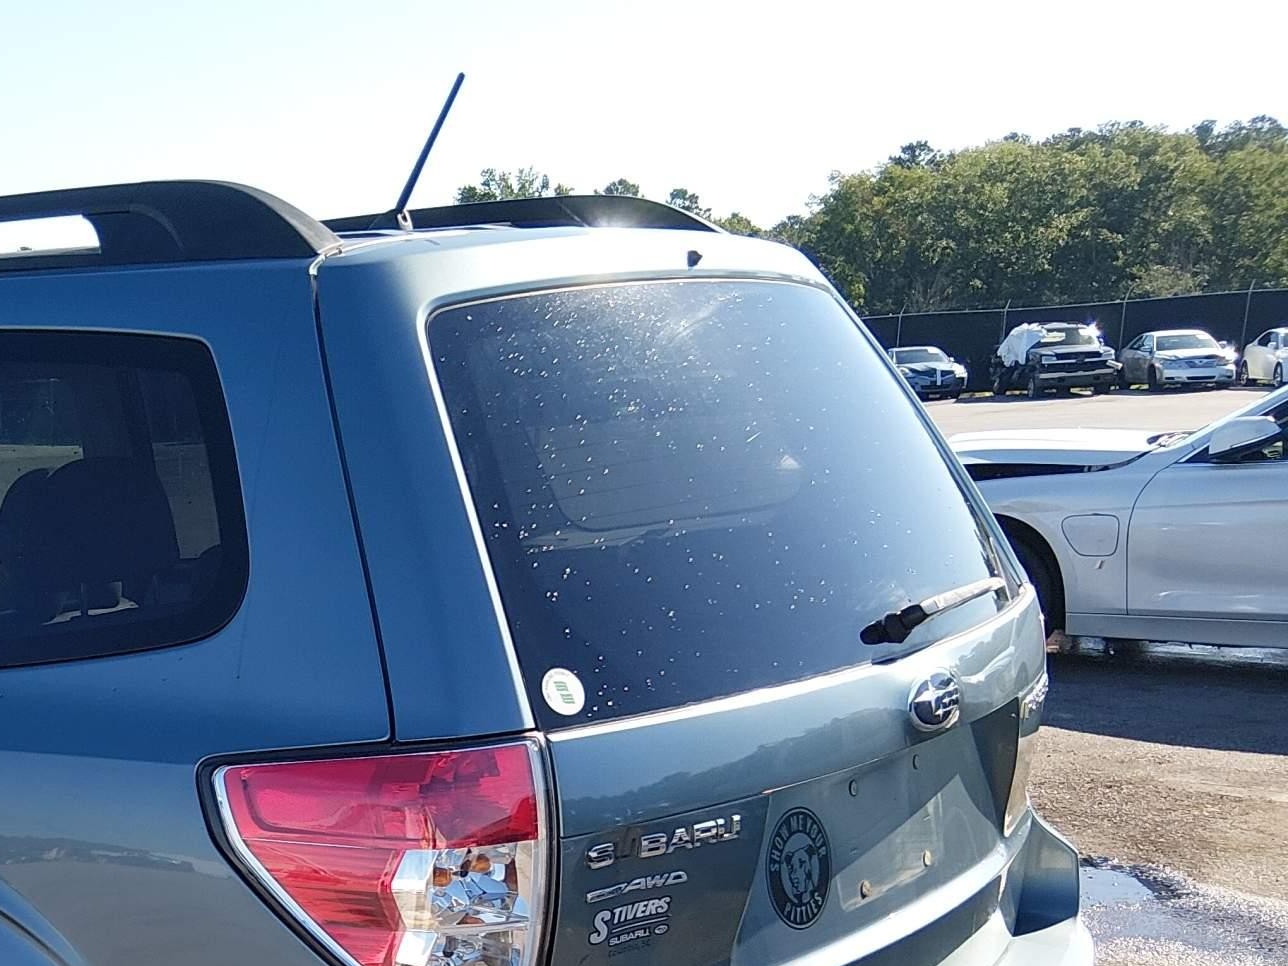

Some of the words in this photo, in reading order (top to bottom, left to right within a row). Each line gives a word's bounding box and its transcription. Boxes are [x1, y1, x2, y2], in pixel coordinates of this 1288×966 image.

[586, 814, 741, 870] SBARU
[770, 824, 790, 873] SHOW
[790, 815, 804, 831] ME
[806, 816, 826, 857] YOUR
[622, 871, 688, 893] AWD
[589, 897, 671, 944] STIVERS
[784, 893, 823, 923] PITTIES
[609, 927, 651, 947] SUBARU
